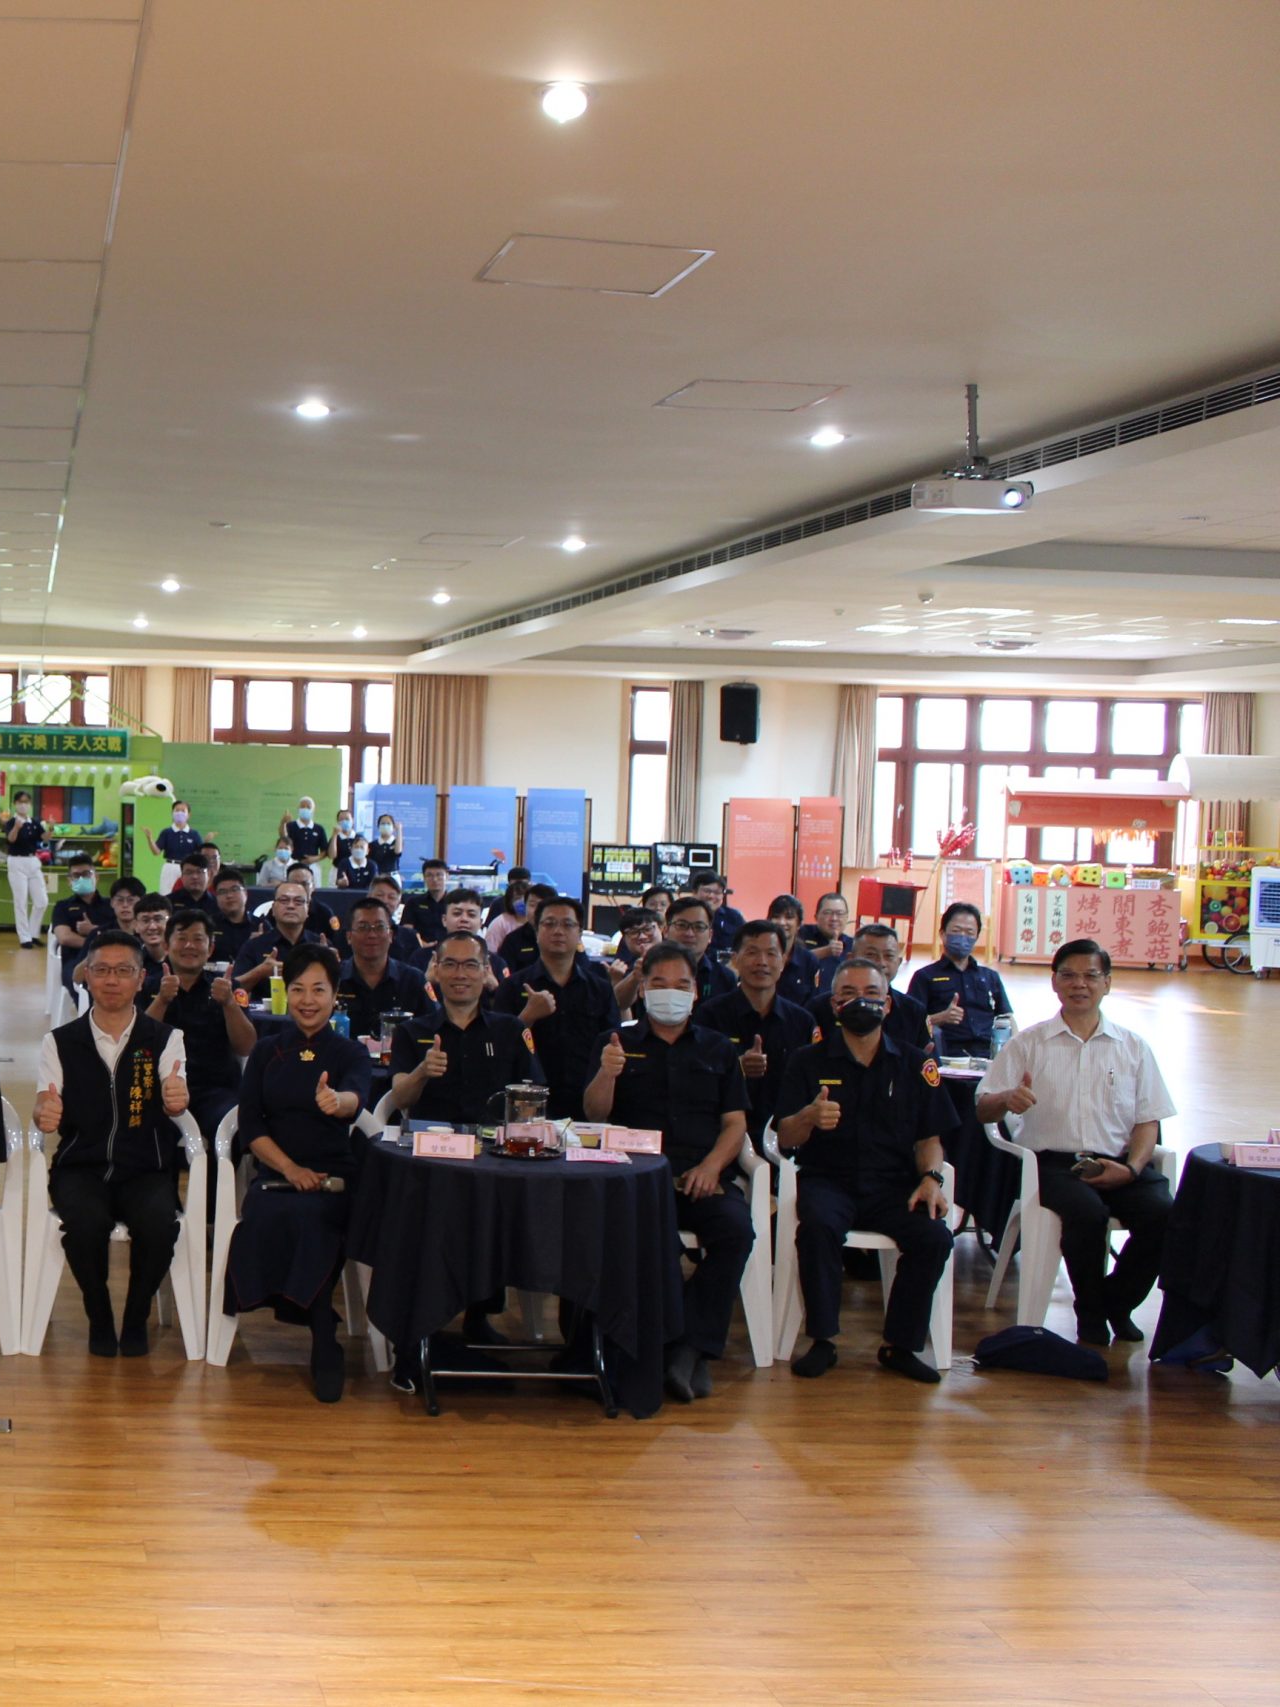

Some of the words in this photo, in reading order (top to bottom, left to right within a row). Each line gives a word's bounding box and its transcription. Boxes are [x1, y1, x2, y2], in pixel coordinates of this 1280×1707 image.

[1075, 894, 1102, 940] 烤地
[1110, 895, 1136, 958] 關東煮
[1144, 894, 1173, 960] 杏鮑菇
